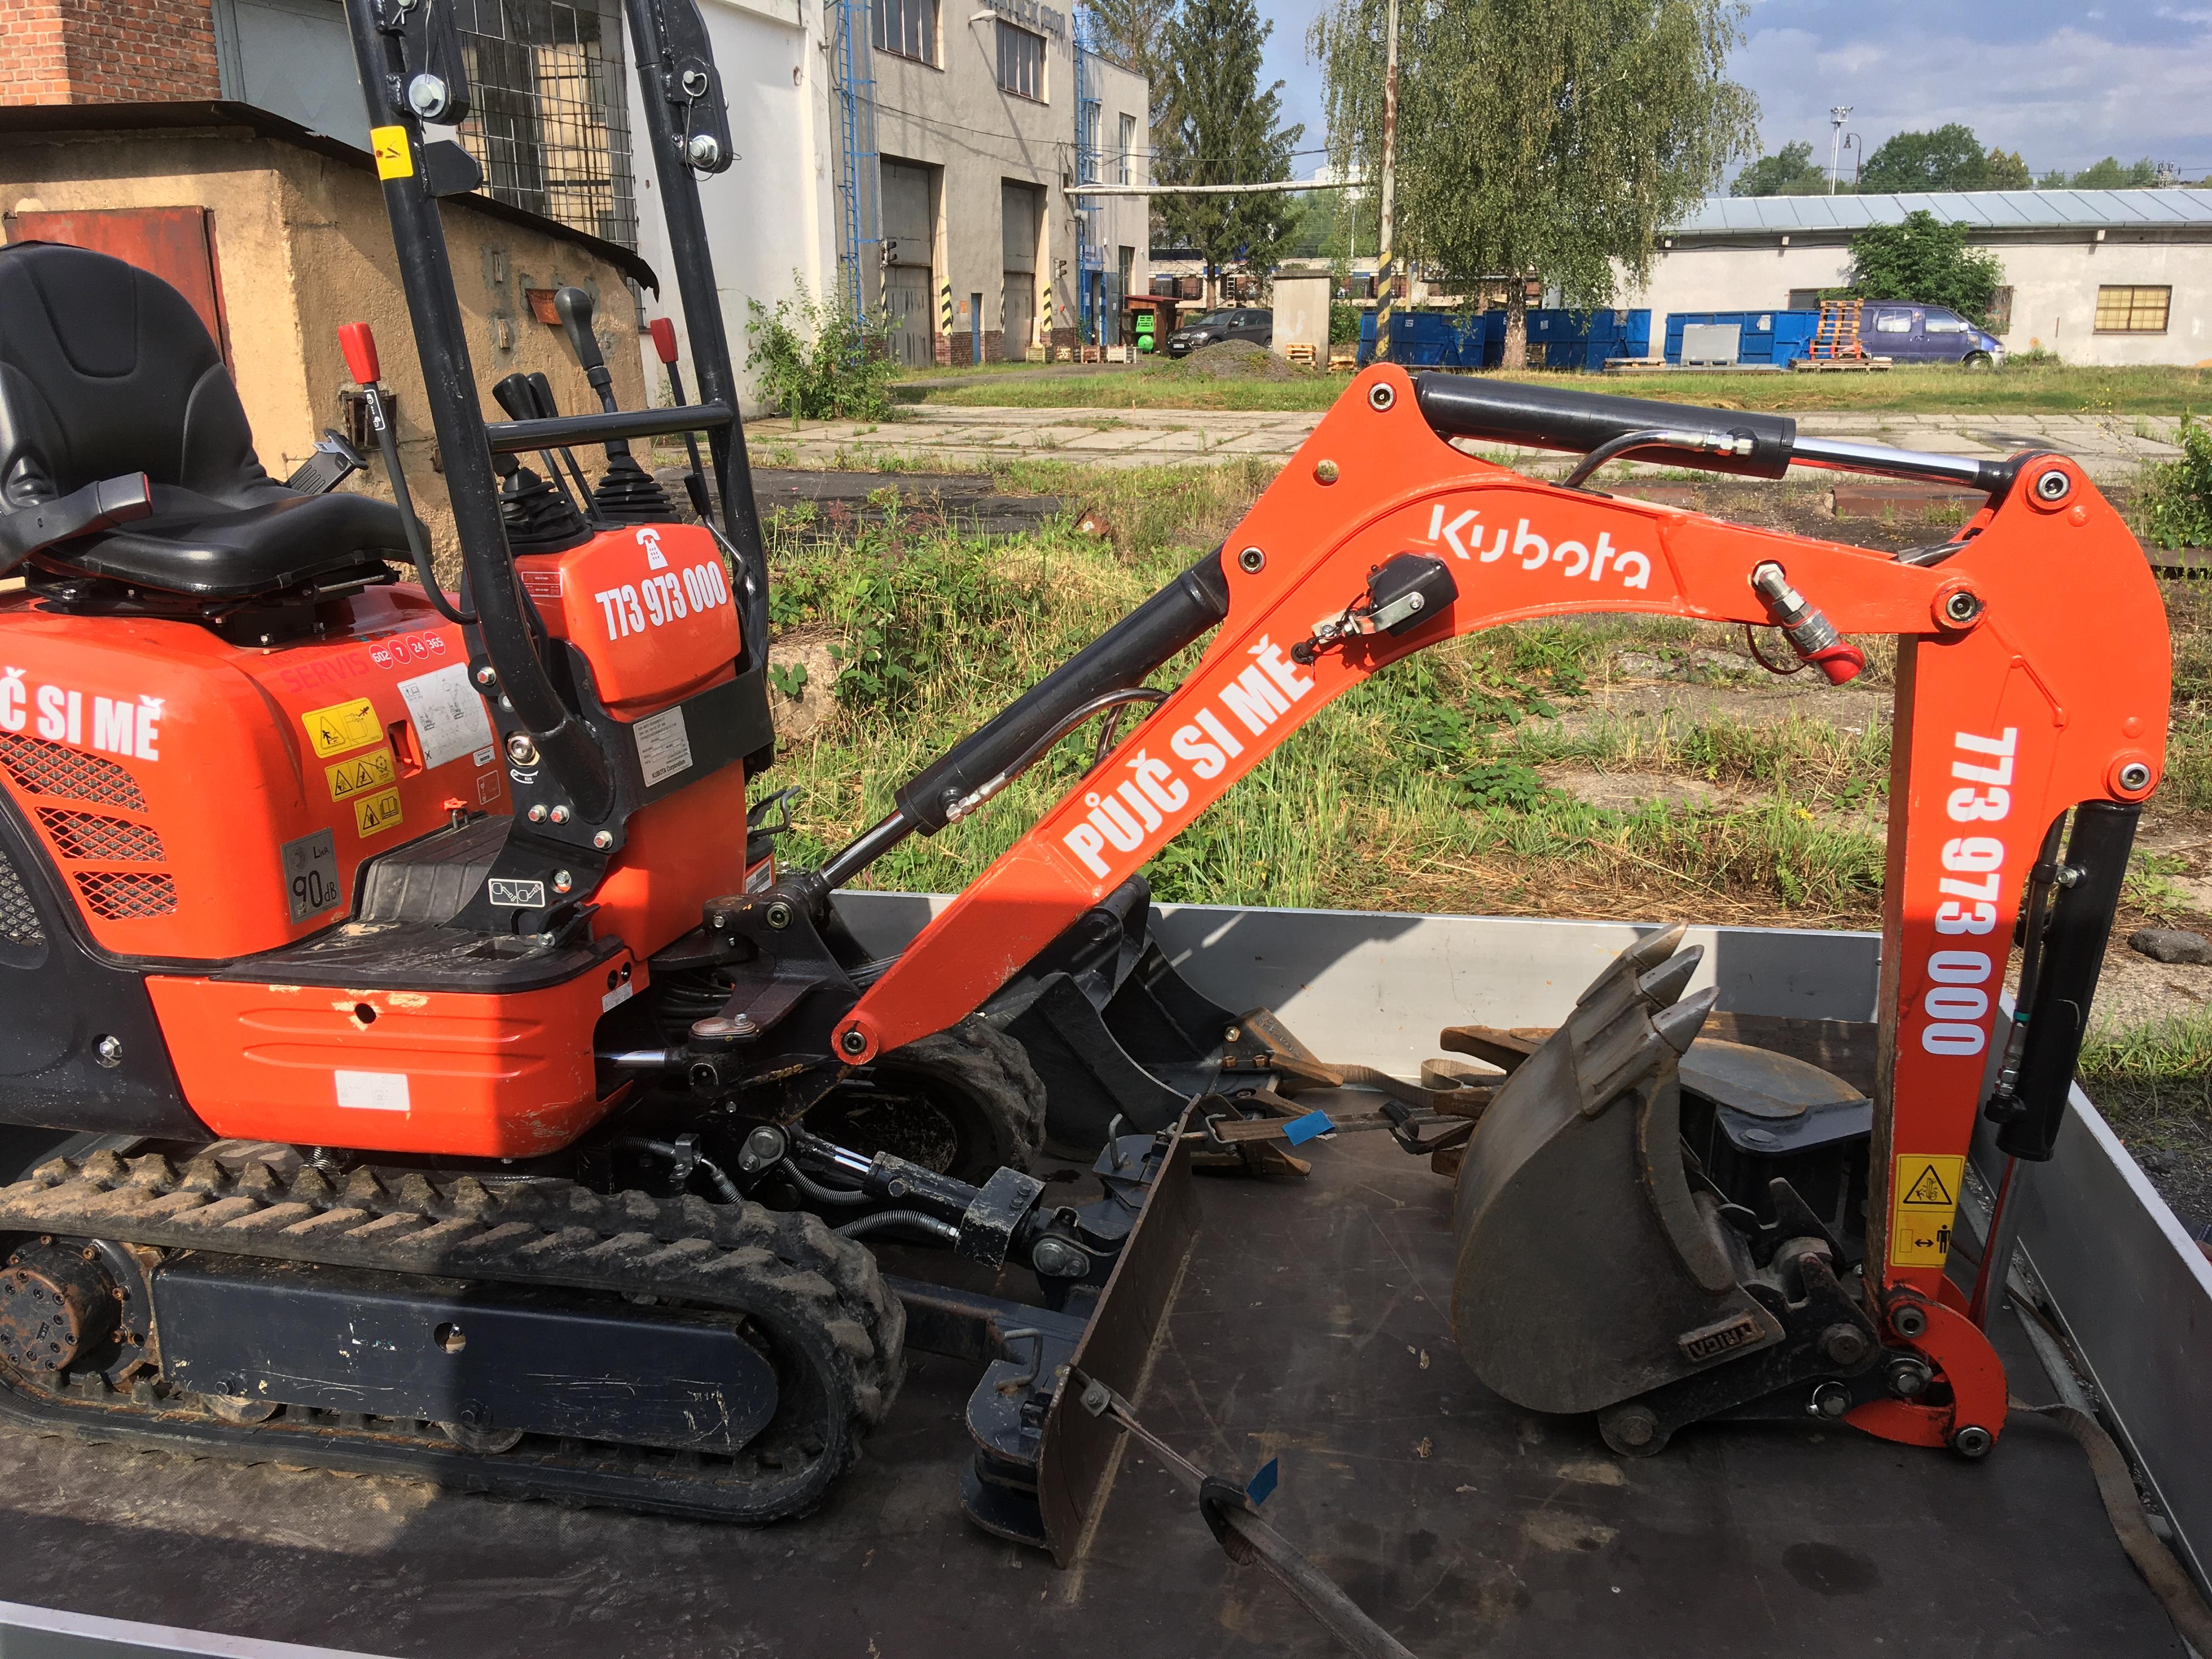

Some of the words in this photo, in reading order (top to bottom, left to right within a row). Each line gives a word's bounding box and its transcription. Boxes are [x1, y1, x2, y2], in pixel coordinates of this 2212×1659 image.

[1428, 504, 1651, 589] Kubota
[594, 585, 645, 641] 773
[641, 572, 687, 627] 973
[682, 561, 727, 613] 000
[280, 653, 369, 693] SERVIS
[372, 650, 390, 662] 602
[395, 647, 403, 657] 7
[413, 642, 424, 653] 24
[427, 637, 444, 649] 365
[37, 685, 82, 745] SI
[94, 694, 166, 761] MĚ
[1063, 748, 1189, 879] PŮJČ
[1170, 707, 1244, 780] SI
[1218, 634, 1314, 737] MĚ
[379, 772, 390, 780] STOP
[1947, 727, 2017, 822] 773
[1935, 837, 2004, 935] 973
[1922, 950, 1991, 1056] 000
